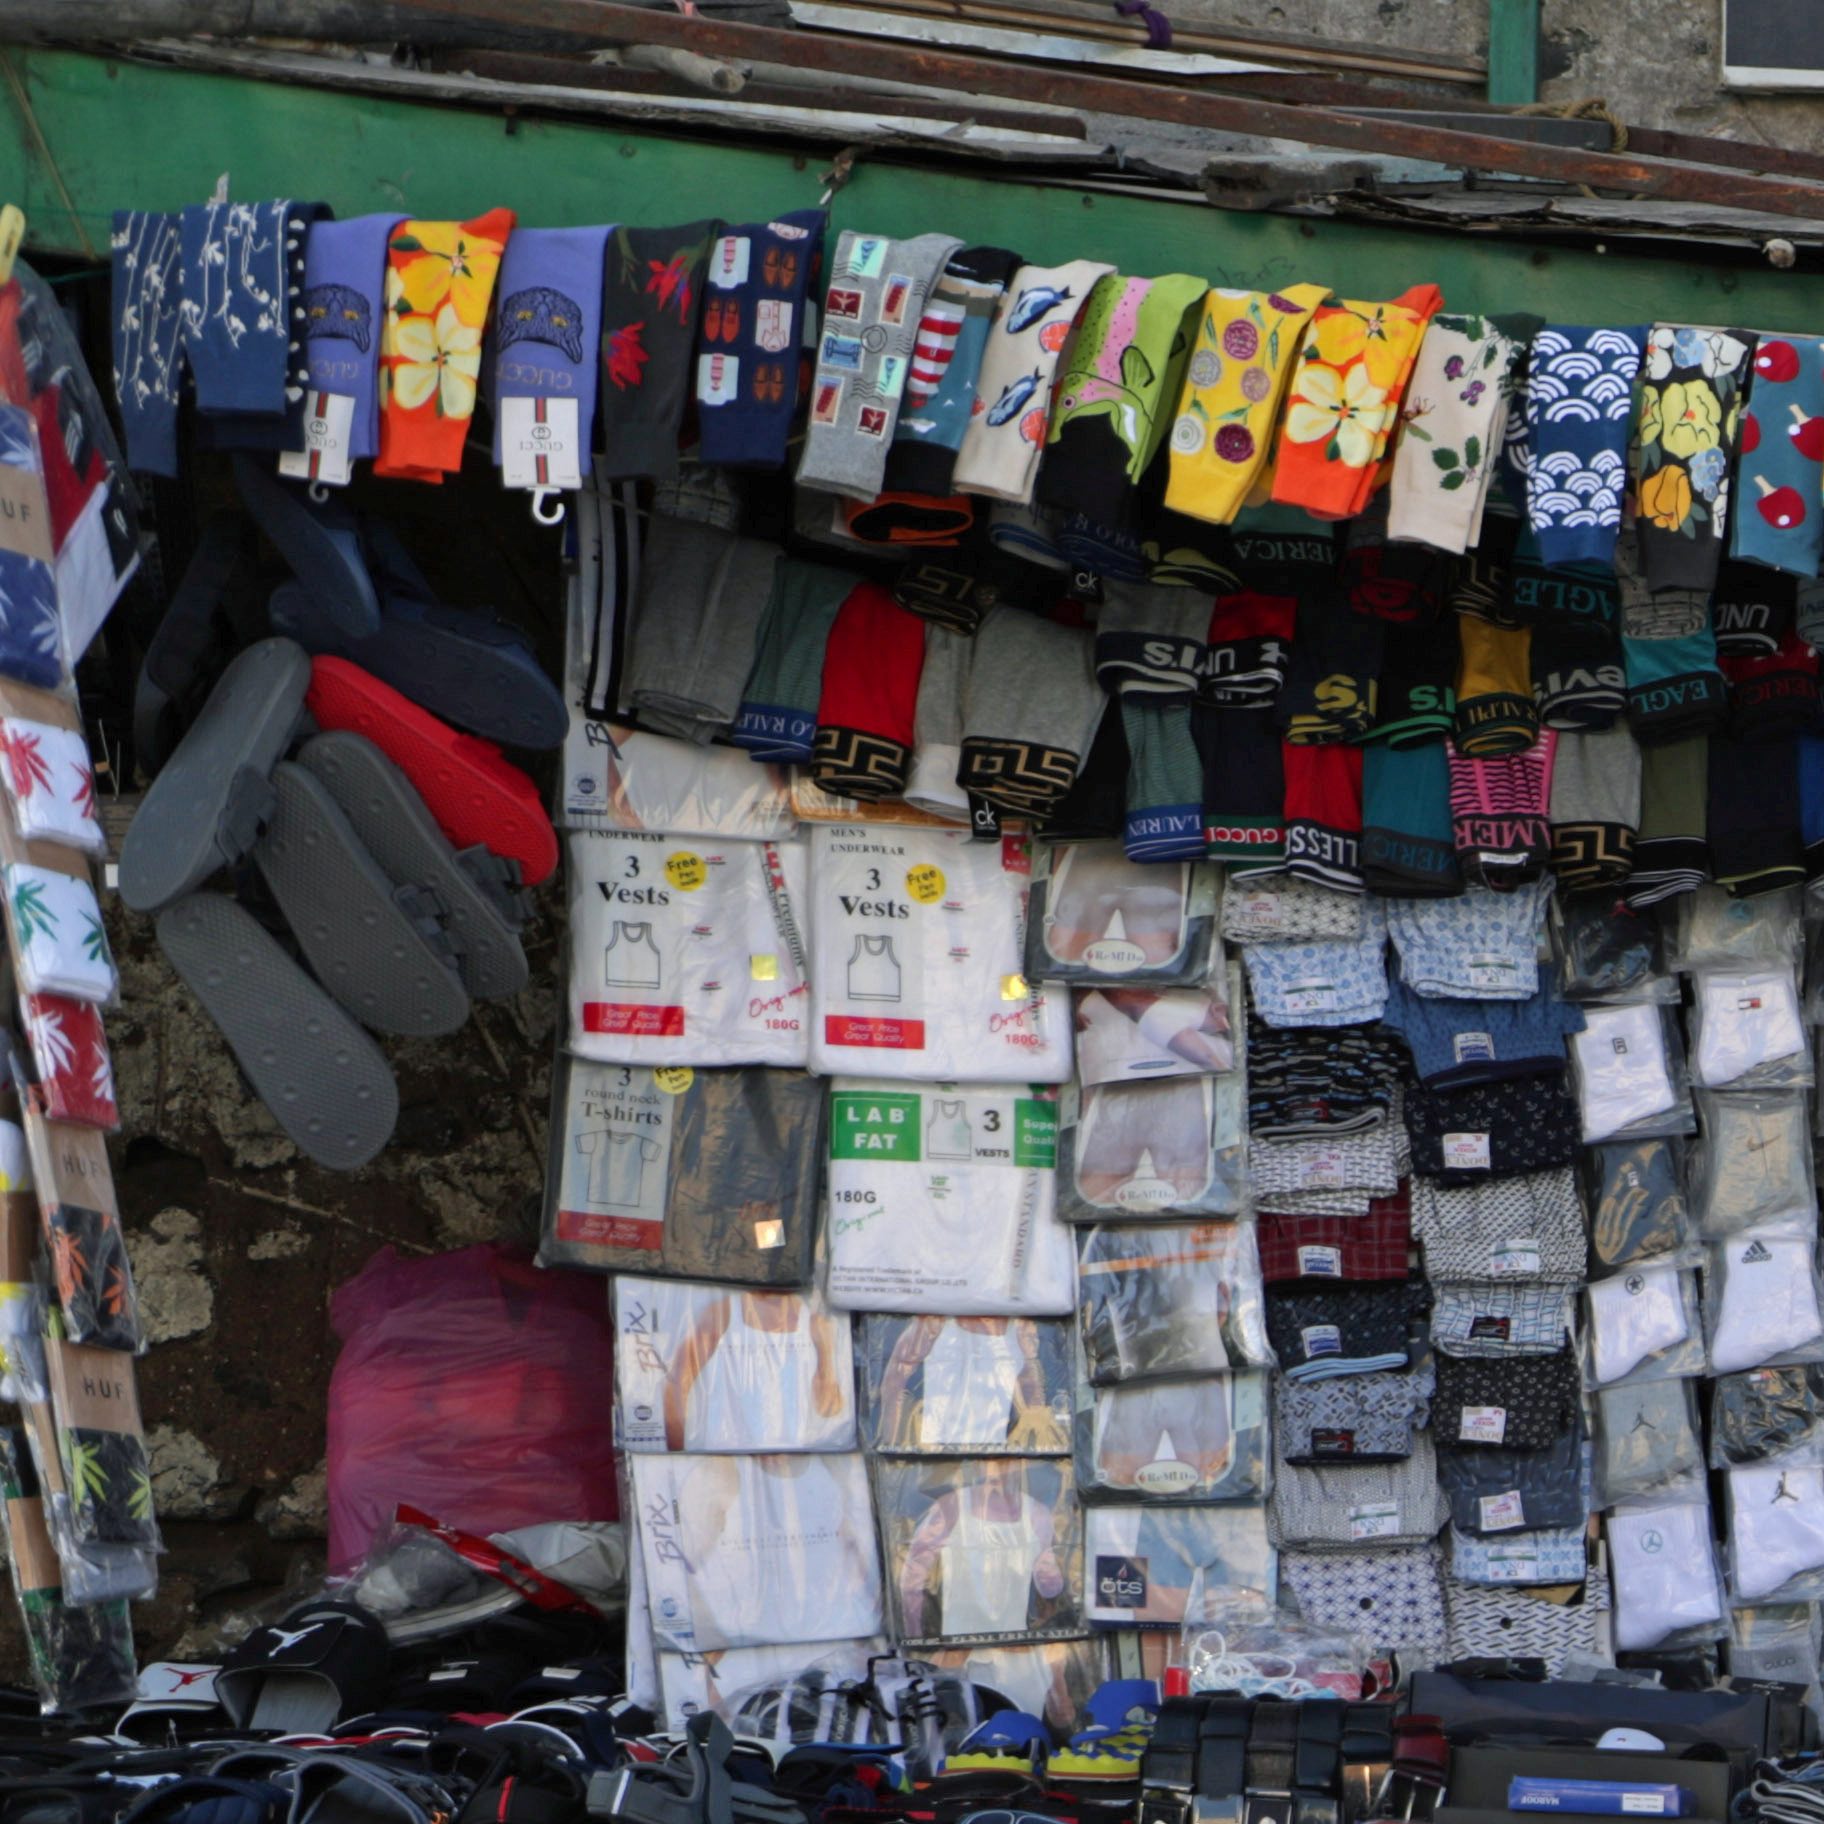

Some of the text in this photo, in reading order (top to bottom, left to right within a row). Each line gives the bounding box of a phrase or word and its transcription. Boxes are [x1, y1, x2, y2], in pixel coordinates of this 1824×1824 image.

[520, 439, 564, 451] GUCCI
[1074, 571, 1098, 591] ck
[974, 801, 996, 826] ck
[829, 827, 867, 839] MEN'S
[1217, 826, 1279, 844] GUCCI
[830, 843, 905, 857] UNDERWEAR
[624, 855, 641, 878] 3
[667, 857, 698, 872] Free
[866, 867, 882, 891] 3
[906, 869, 938, 885] Free
[596, 881, 671, 907] Vests
[838, 894, 911, 919] Vests
[765, 1018, 800, 1031] 180G
[1004, 1033, 1039, 1047] 180G
[618, 1066, 632, 1087] 3
[584, 1086, 661, 1106] round neck
[581, 1100, 663, 1127] T-shirts
[983, 1108, 1001, 1132] 3
[854, 1132, 898, 1150] FAT
[975, 1147, 1010, 1158] VESTS
[834, 1190, 878, 1204] 180G
[624, 1301, 672, 1384] Brix
[645, 1493, 696, 1575] Brix
